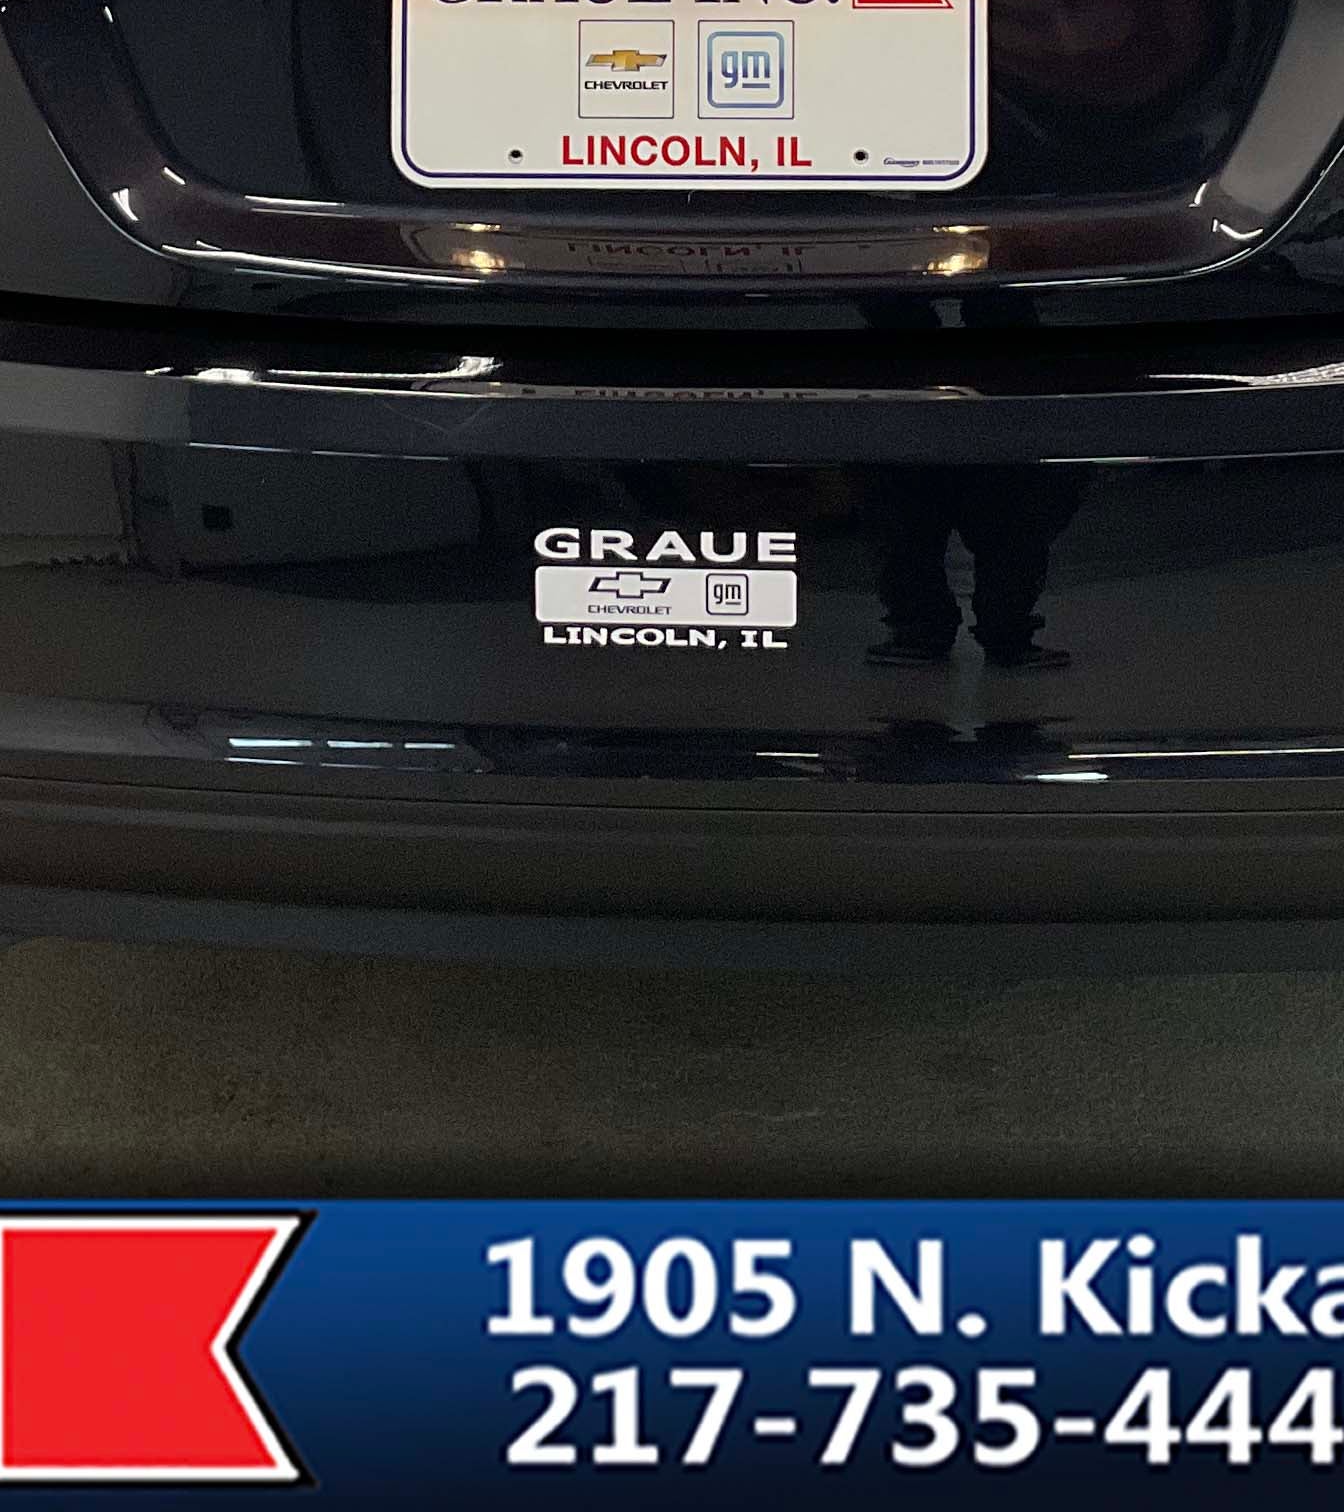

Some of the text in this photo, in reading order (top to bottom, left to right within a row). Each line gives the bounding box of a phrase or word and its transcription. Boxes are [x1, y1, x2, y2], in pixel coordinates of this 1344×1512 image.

[720, 49, 772, 89] gm
[583, 79, 669, 91] CHEVROLET
[560, 134, 813, 172] LINCOLN, IL
[533, 527, 798, 564] GRAUE
[712, 582, 743, 606] gm
[587, 603, 672, 616] CHEVROLET
[543, 626, 789, 651] LINCOLN, IL
